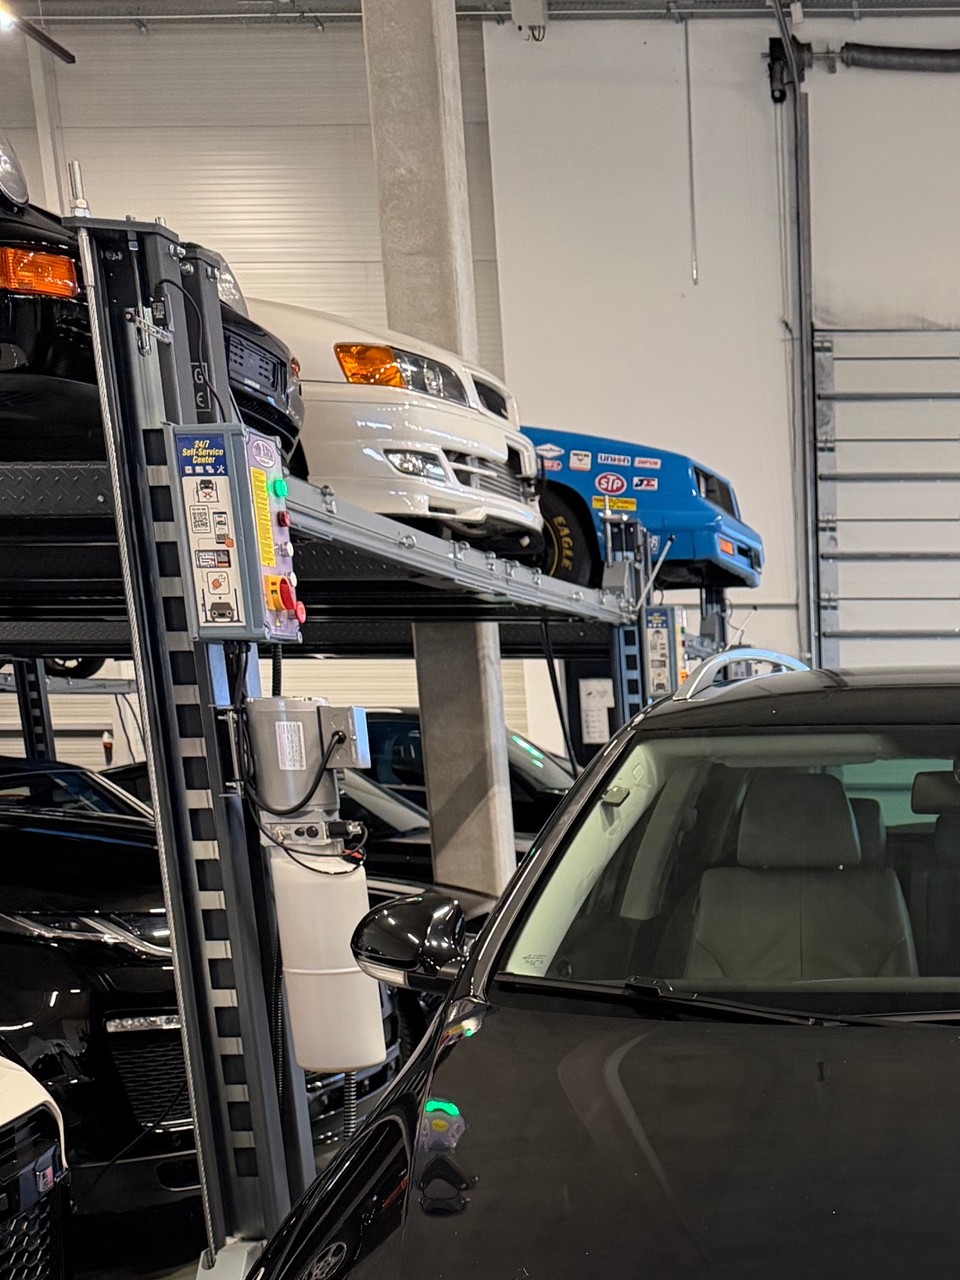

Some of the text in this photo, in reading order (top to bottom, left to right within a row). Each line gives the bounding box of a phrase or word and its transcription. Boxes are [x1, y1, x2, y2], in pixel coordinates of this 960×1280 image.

[194, 440, 210, 448] 24/7
[182, 448, 224, 456] Self-Service
[192, 456, 215, 464] Center
[600, 475, 622, 491] STP
[553, 516, 573, 571] EAGLE
